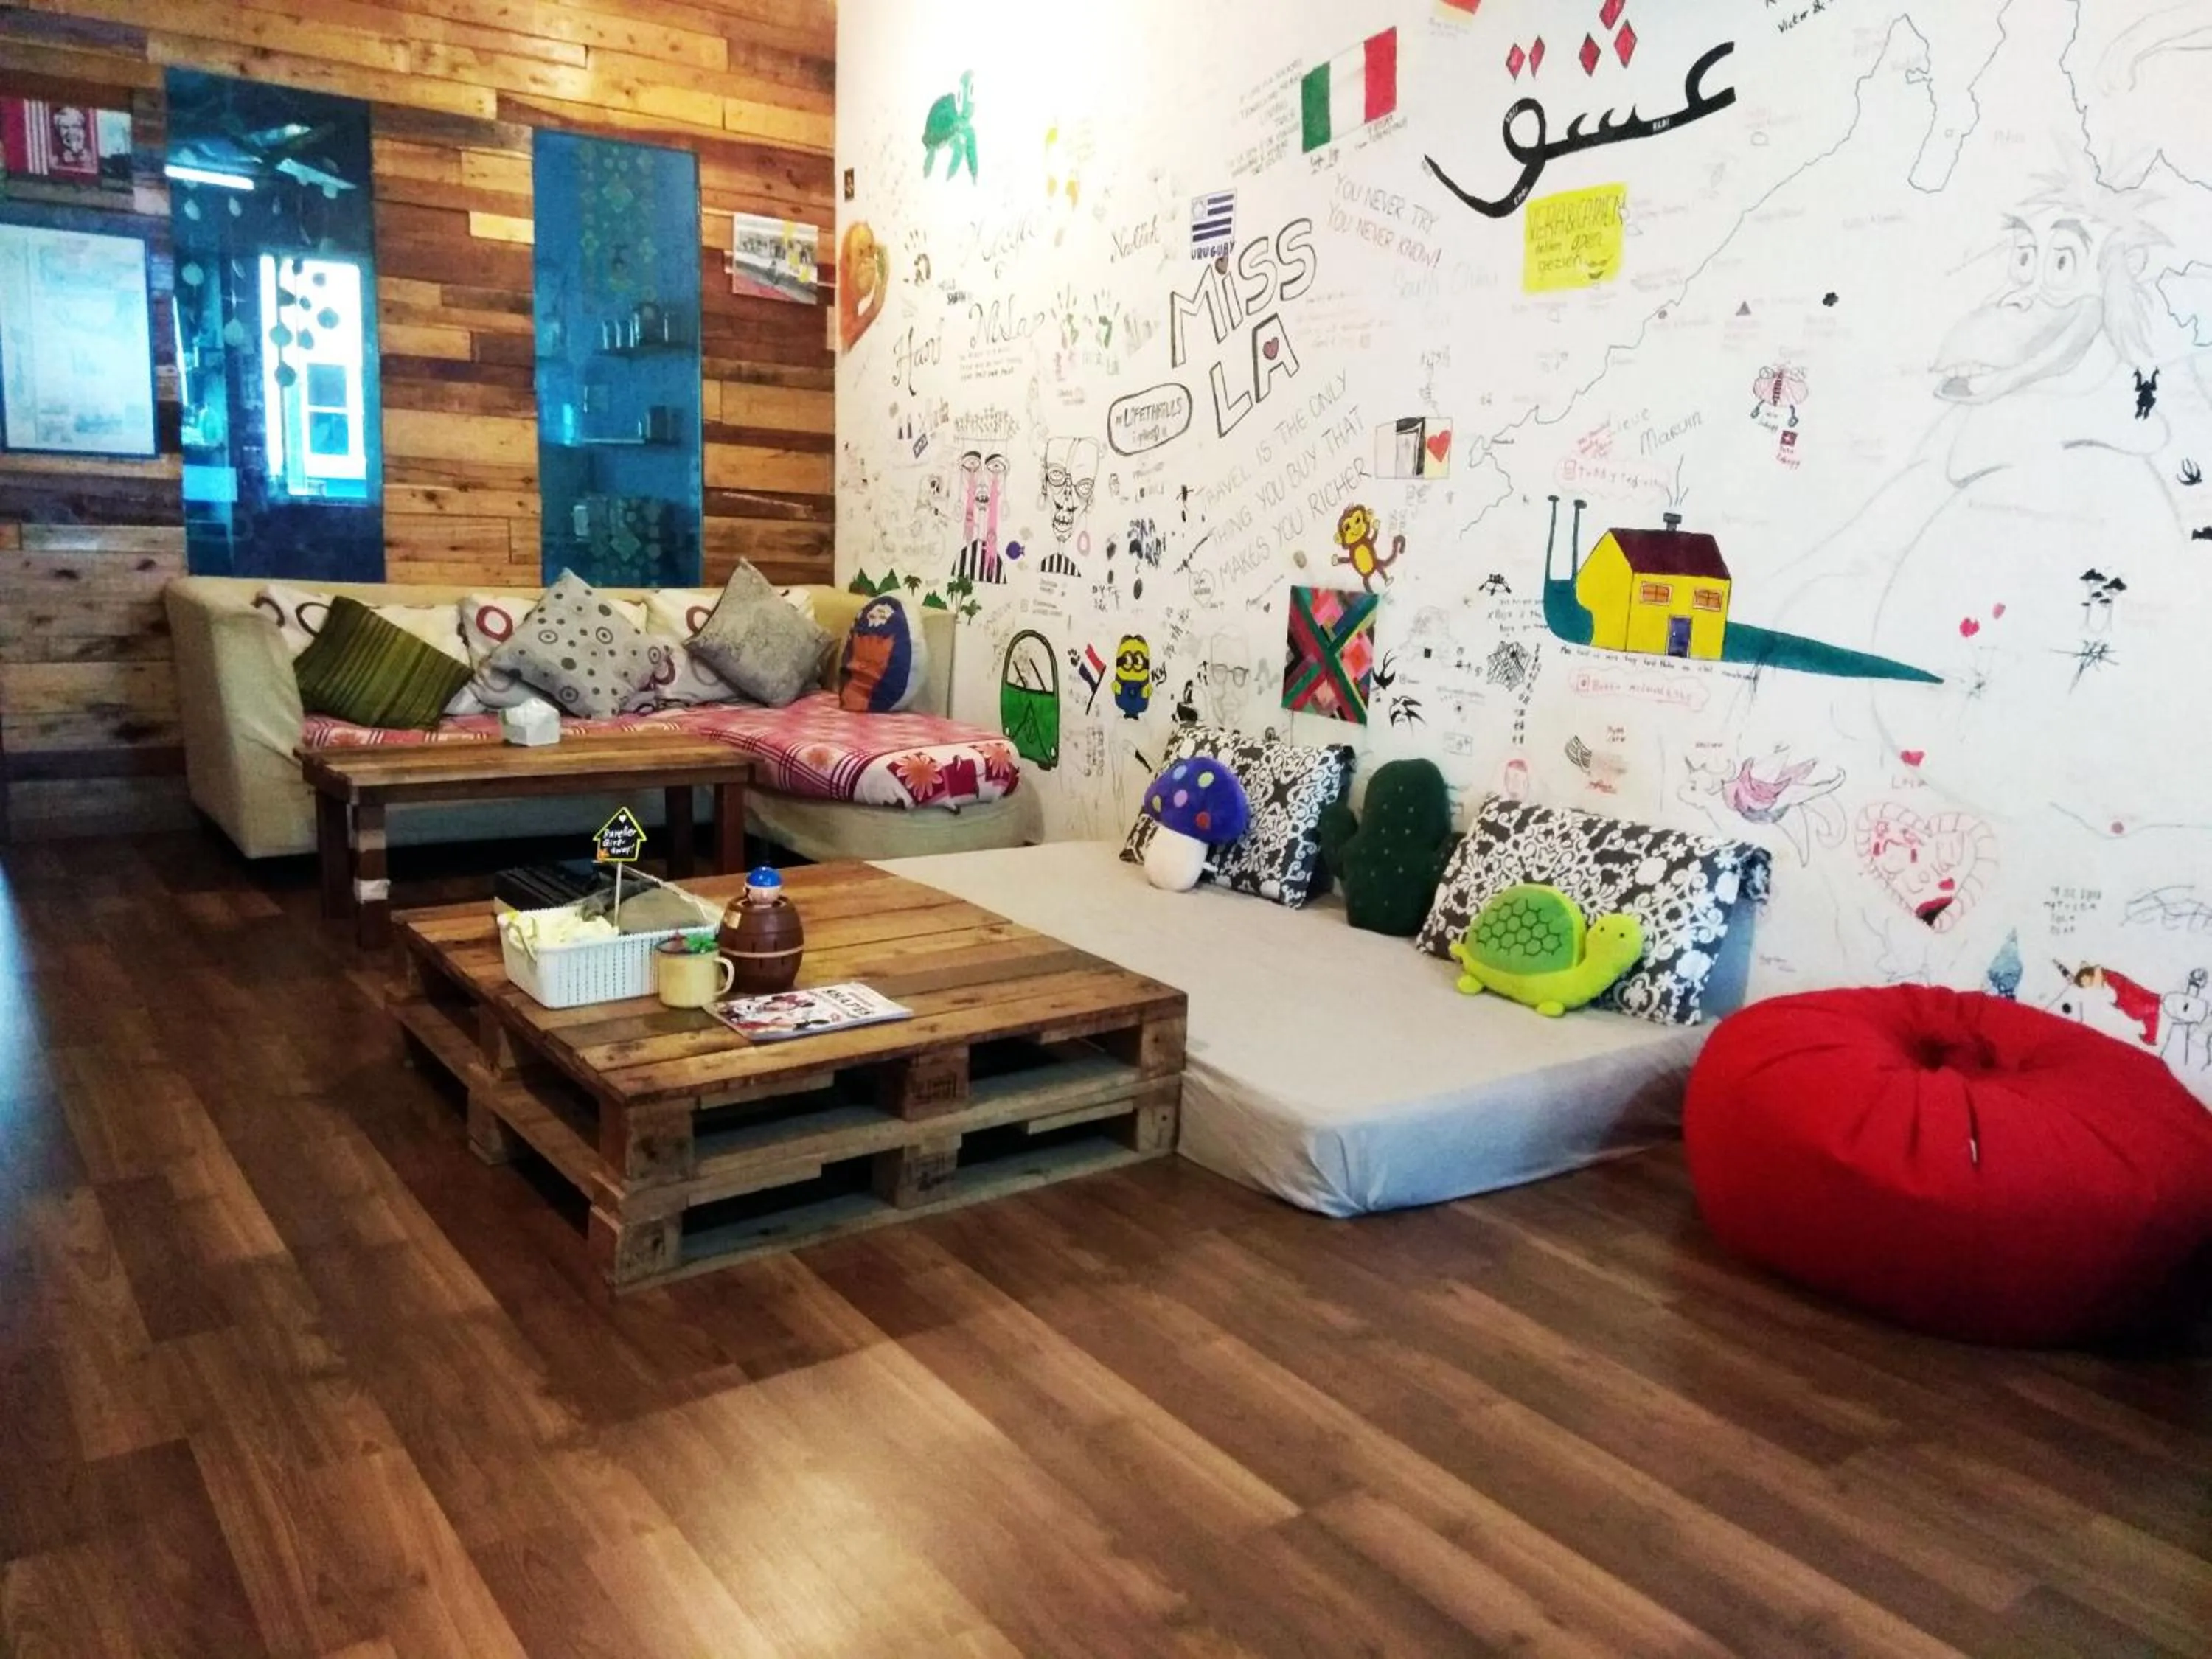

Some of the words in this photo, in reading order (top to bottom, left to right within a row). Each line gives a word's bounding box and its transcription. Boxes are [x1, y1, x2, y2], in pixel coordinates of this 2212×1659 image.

[1190, 240, 1236, 260] URUGUAY
[1326, 200, 1349, 233] YOU
[1356, 218, 1394, 248] NEVER
[1335, 172, 1361, 203] YOU
[1365, 187, 1405, 220] NEVER
[1411, 204, 1440, 235] TRY
[1195, 465, 1252, 511] TRAVEL
[1254, 439, 1273, 466] IS
[1274, 408, 1308, 444] THE
[1308, 366, 1347, 418] ONLY
[1208, 312, 1301, 439] LA
[1209, 504, 1253, 544] THING
[1254, 474, 1286, 510] YOU
[1286, 443, 1318, 489] BUY
[1320, 404, 1366, 457] THAT
[1219, 535, 1271, 588] MAKES
[1272, 508, 1304, 549] YOU
[1307, 456, 1372, 520] RICHER
